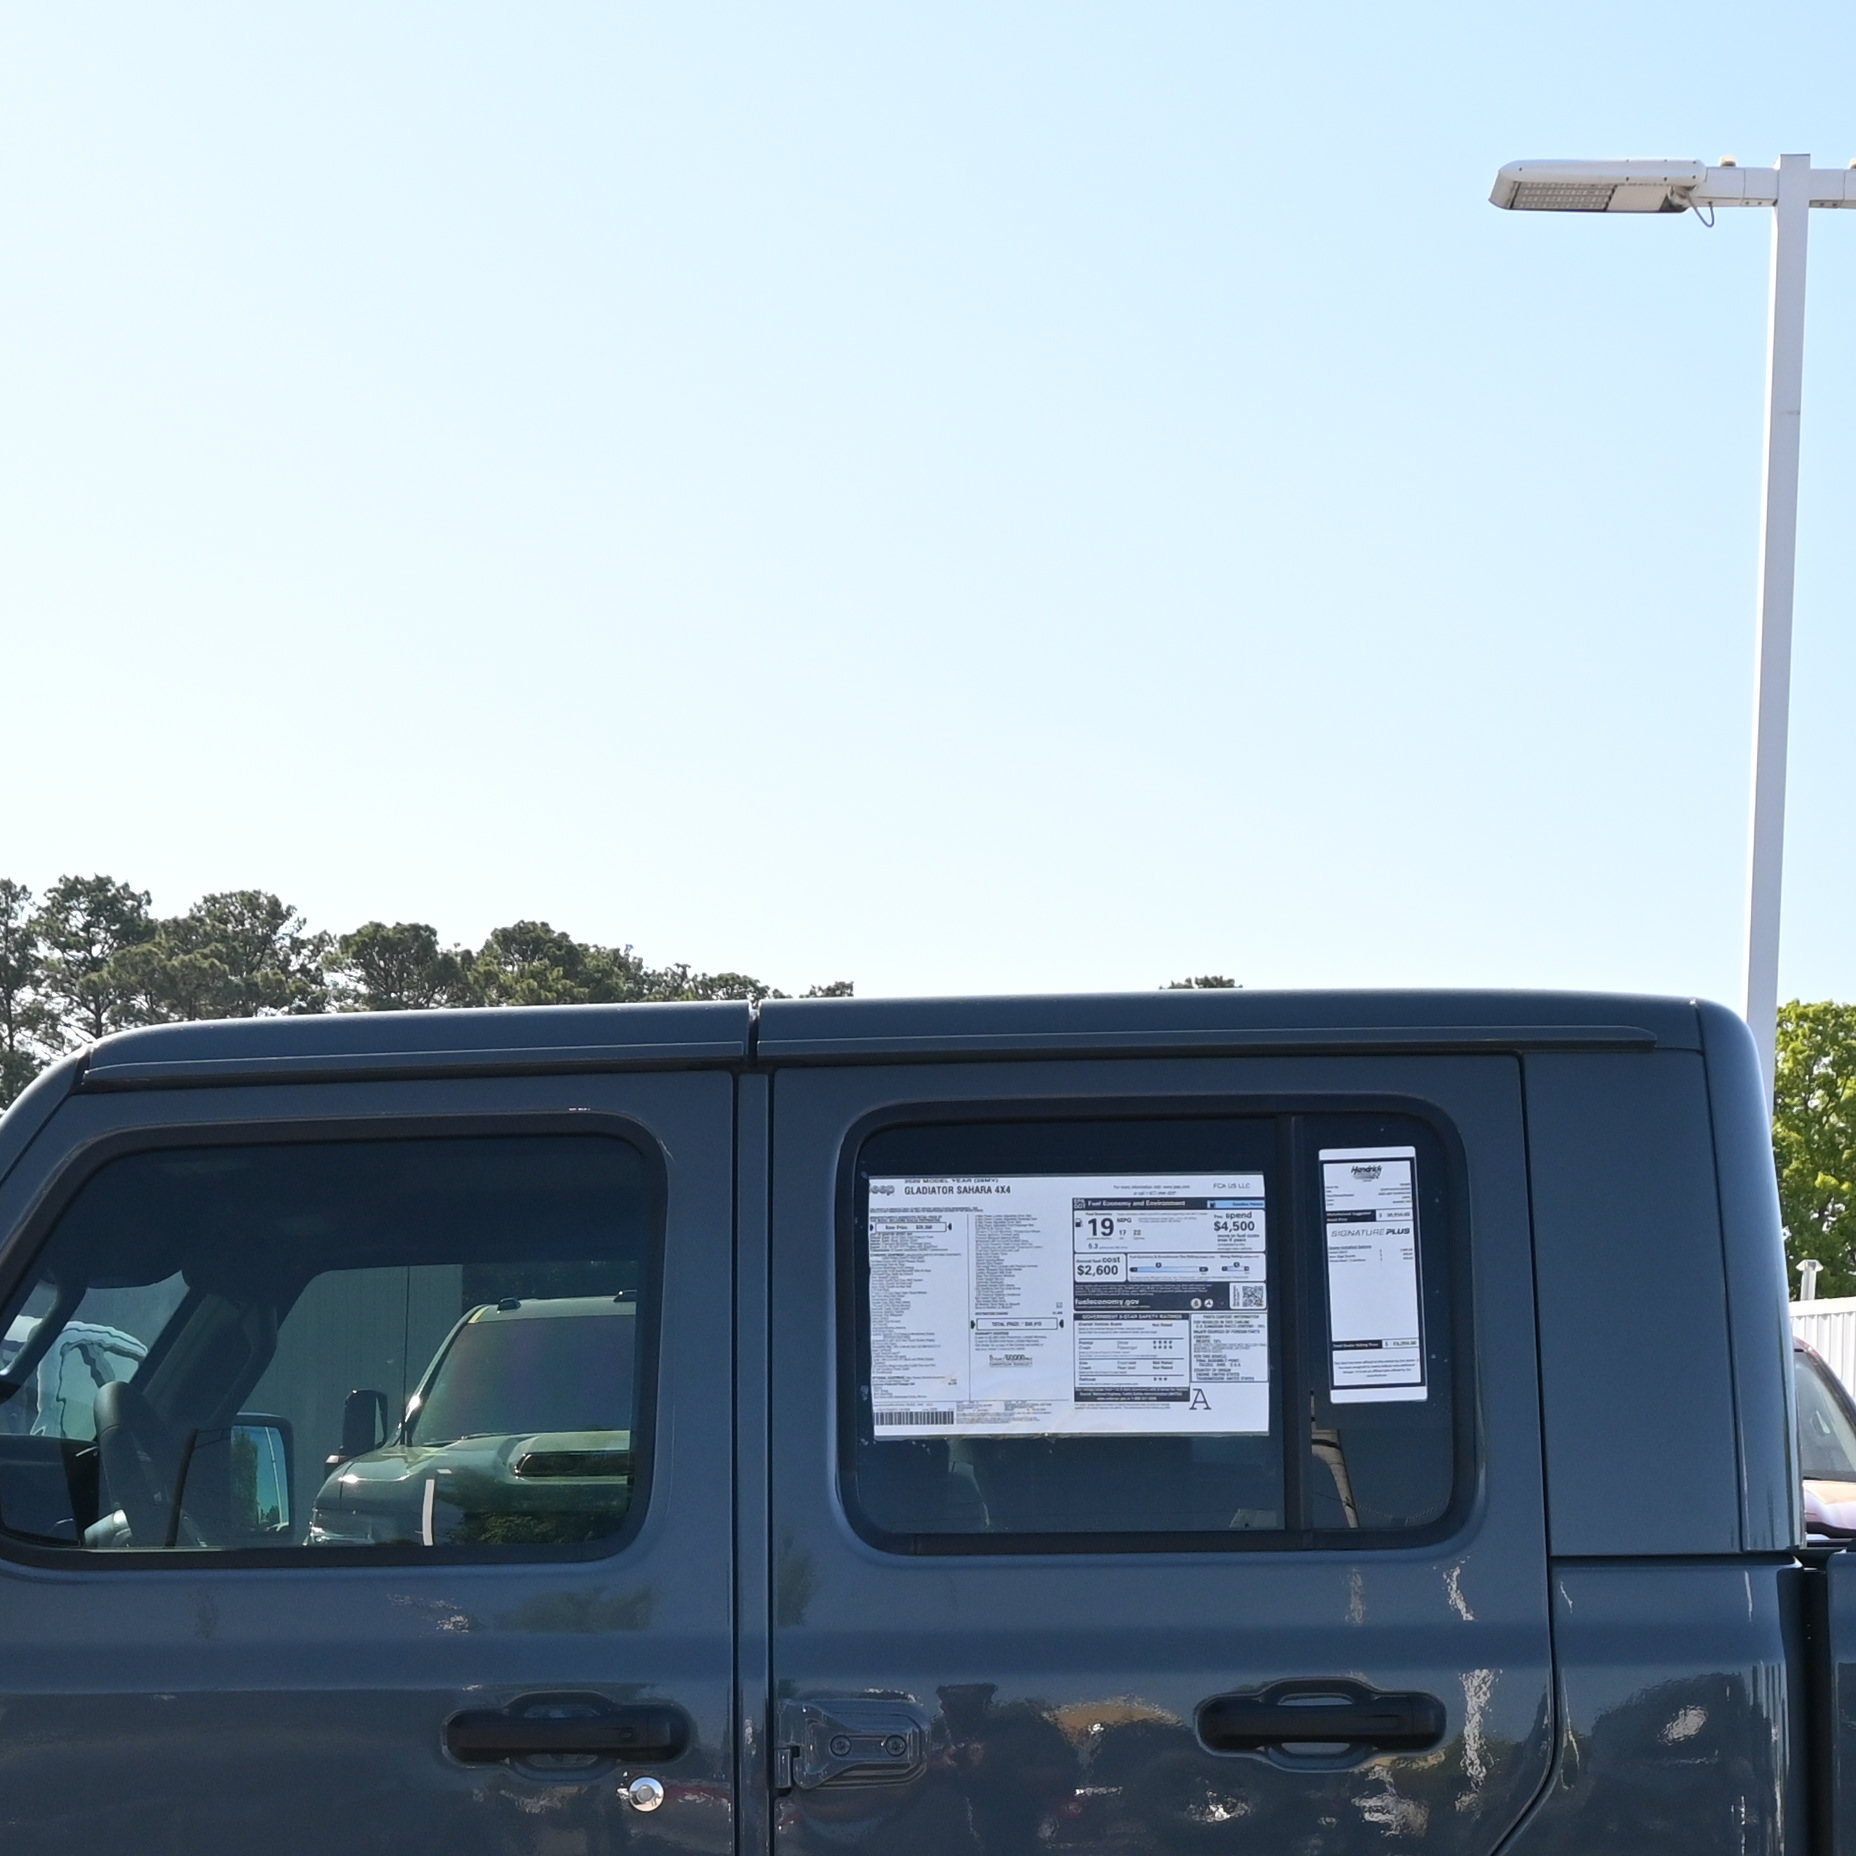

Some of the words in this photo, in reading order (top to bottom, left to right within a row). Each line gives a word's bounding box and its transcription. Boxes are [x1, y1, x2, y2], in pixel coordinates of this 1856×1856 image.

[869, 1184, 895, 1196] eep
[904, 1185, 954, 1195] GLADIATOR
[956, 1185, 993, 1194] SAHARA
[994, 1184, 1011, 1194] 4X4
[1102, 1200, 1131, 1208] Economy
[1145, 1199, 1186, 1207] Environment
[1225, 1211, 1253, 1220] spend
[1087, 1217, 1114, 1236] 19
[1213, 1220, 1255, 1233] $4,500
[1330, 1228, 1384, 1238] SIGNATURE
[1385, 1227, 1411, 1236] PLUS
[1077, 1265, 1119, 1277] $2,600
[1189, 1388, 1212, 1410] A
